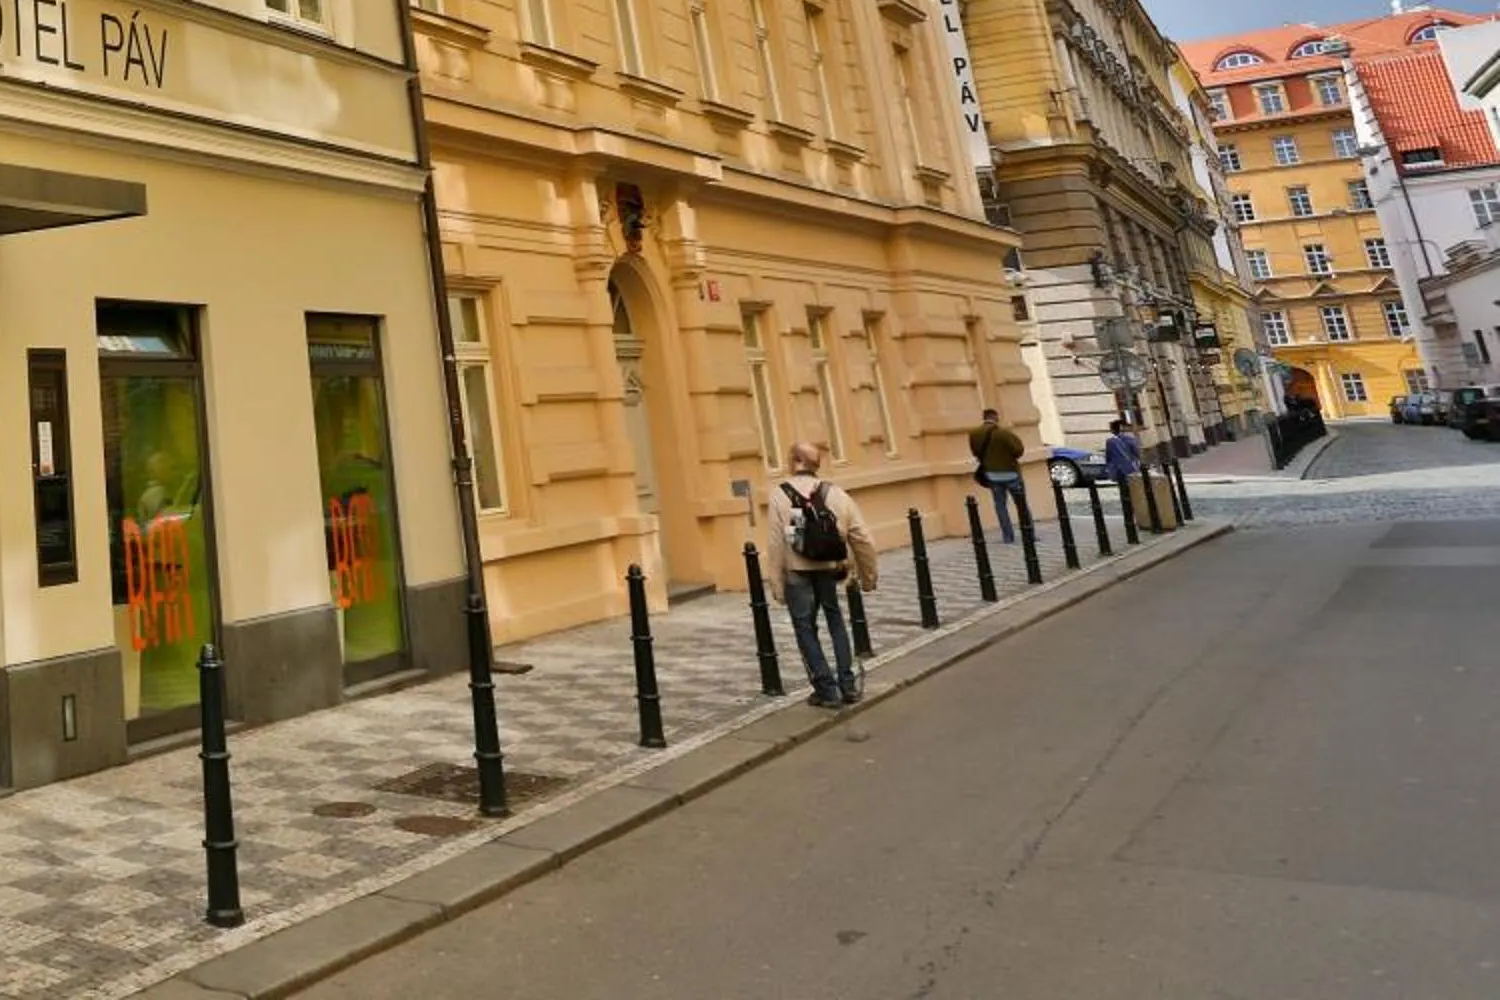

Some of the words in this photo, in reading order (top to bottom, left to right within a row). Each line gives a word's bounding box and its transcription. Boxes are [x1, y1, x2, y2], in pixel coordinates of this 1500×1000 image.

[100, 9, 168, 89] PÁV
[953, 57, 979, 133] PÁV
[121, 512, 196, 653] BAR
